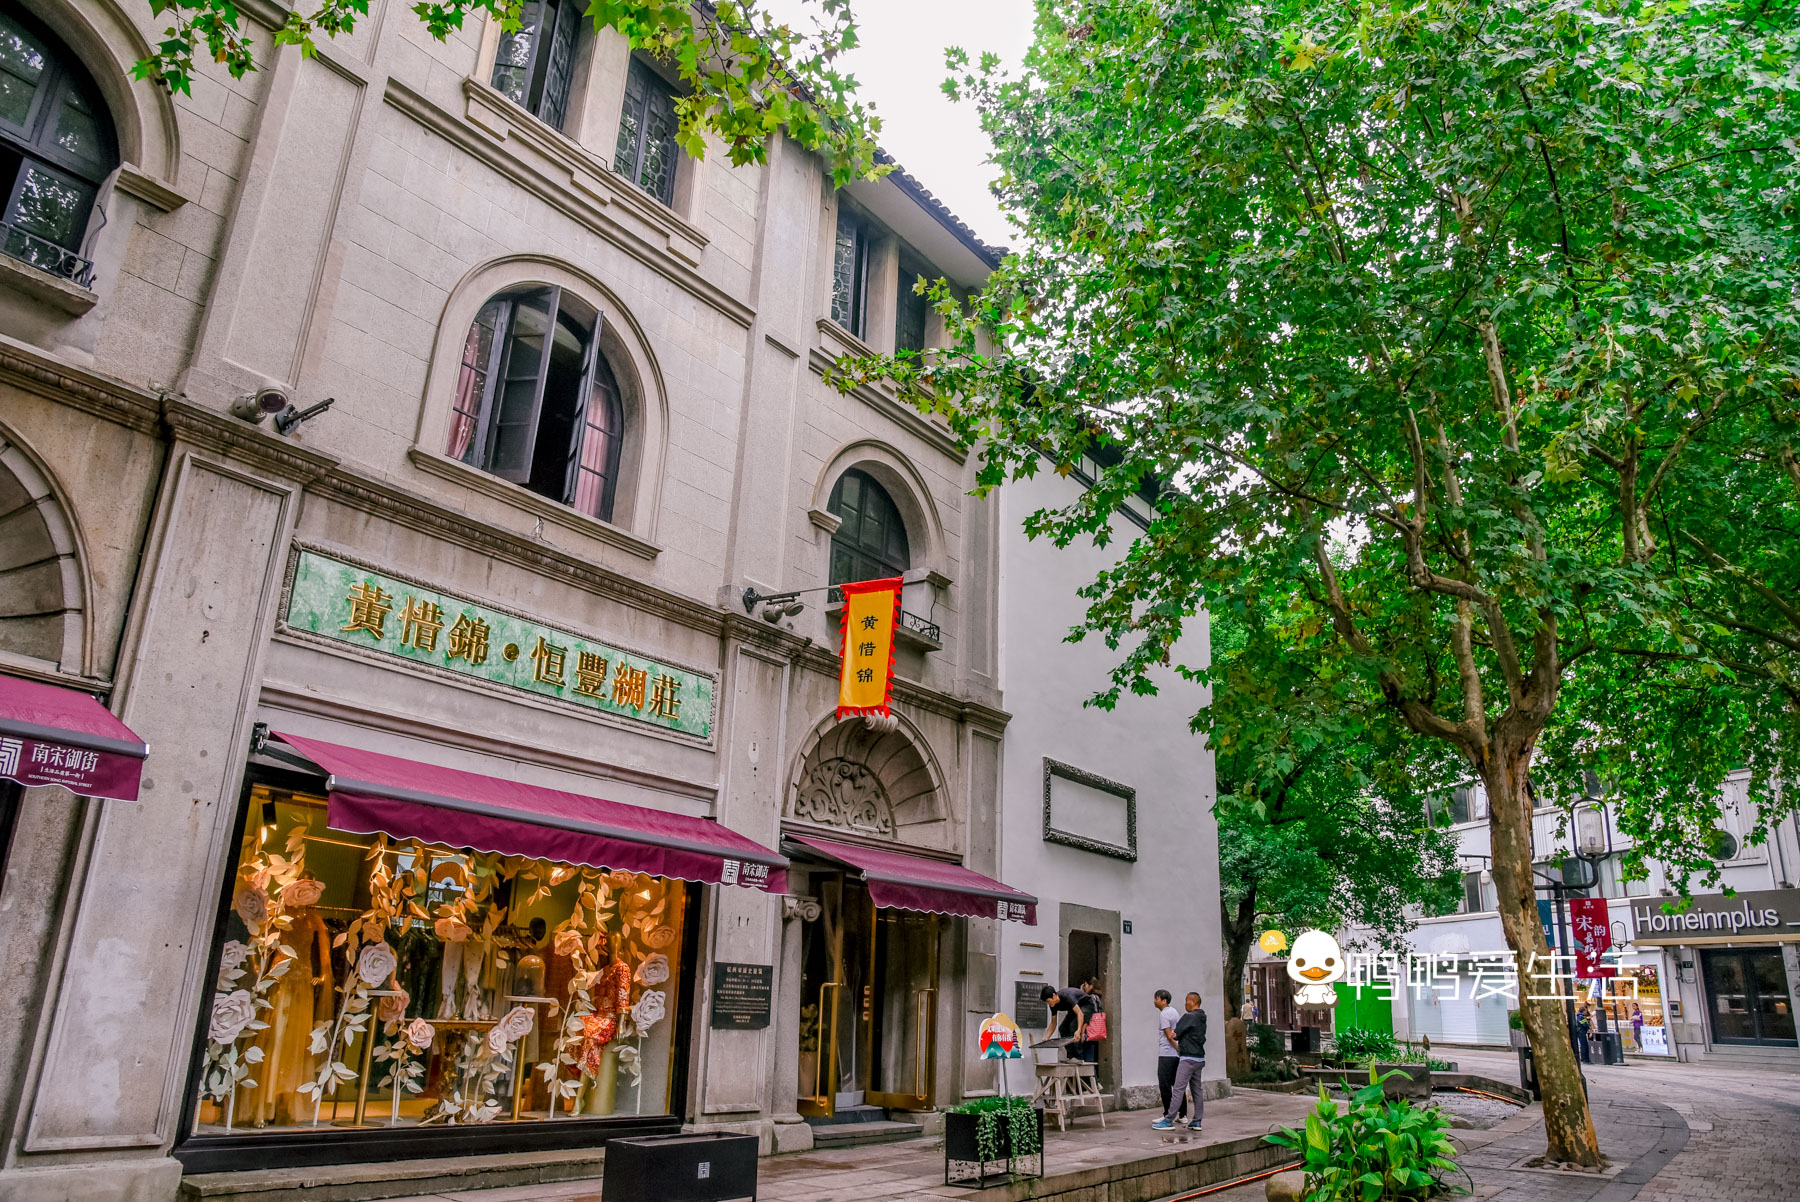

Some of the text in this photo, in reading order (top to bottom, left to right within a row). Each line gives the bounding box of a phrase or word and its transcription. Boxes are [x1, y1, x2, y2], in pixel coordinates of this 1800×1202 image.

[856, 615, 878, 683] 黄惜锦
[32, 743, 99, 772] 南宋御街
[1634, 899, 1780, 934] Homeinnplus
